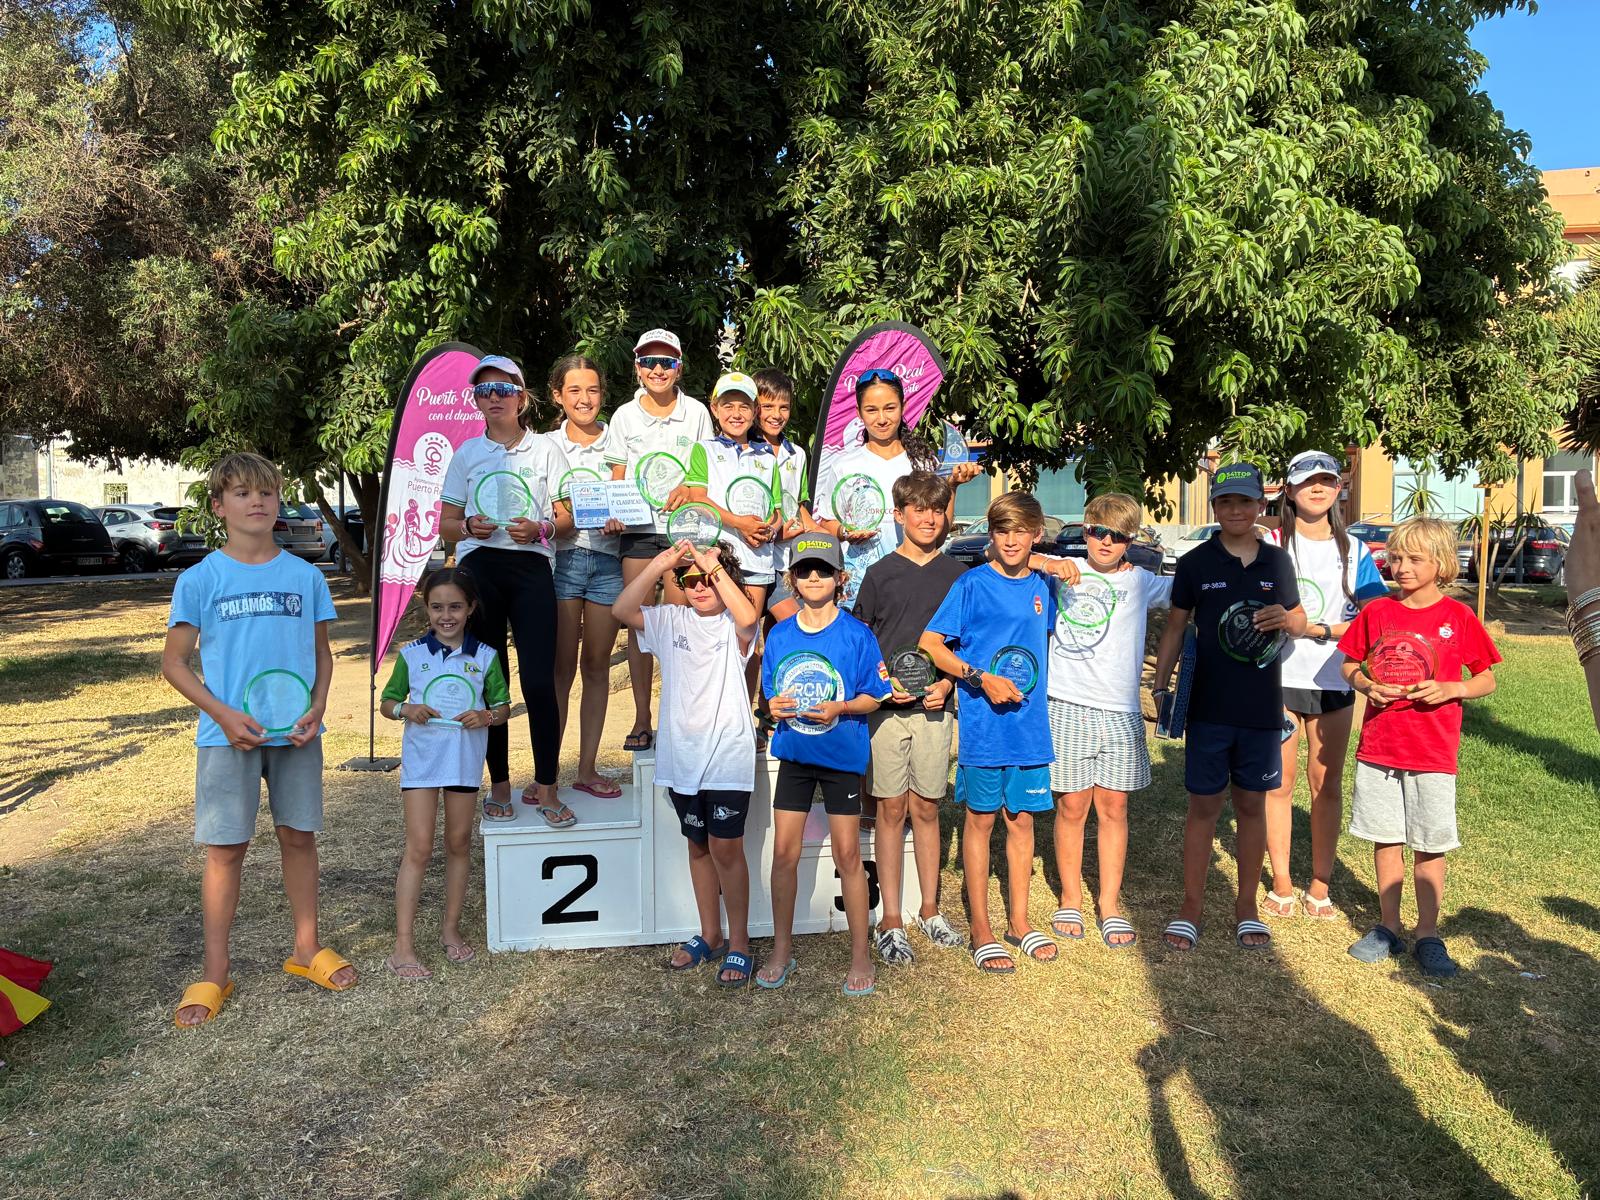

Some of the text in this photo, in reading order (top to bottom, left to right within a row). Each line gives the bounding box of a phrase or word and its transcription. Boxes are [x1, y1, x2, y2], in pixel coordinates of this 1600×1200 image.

[891, 361, 926, 384] Real
[416, 386, 478, 410] Puerto R
[428, 409, 486, 425] con el deporte
[408, 480, 433, 493] Puerto
[220, 594, 274, 617] PALAMÓS
[793, 683, 830, 698] RCM
[541, 854, 598, 925] 2
[834, 860, 880, 912] 3
